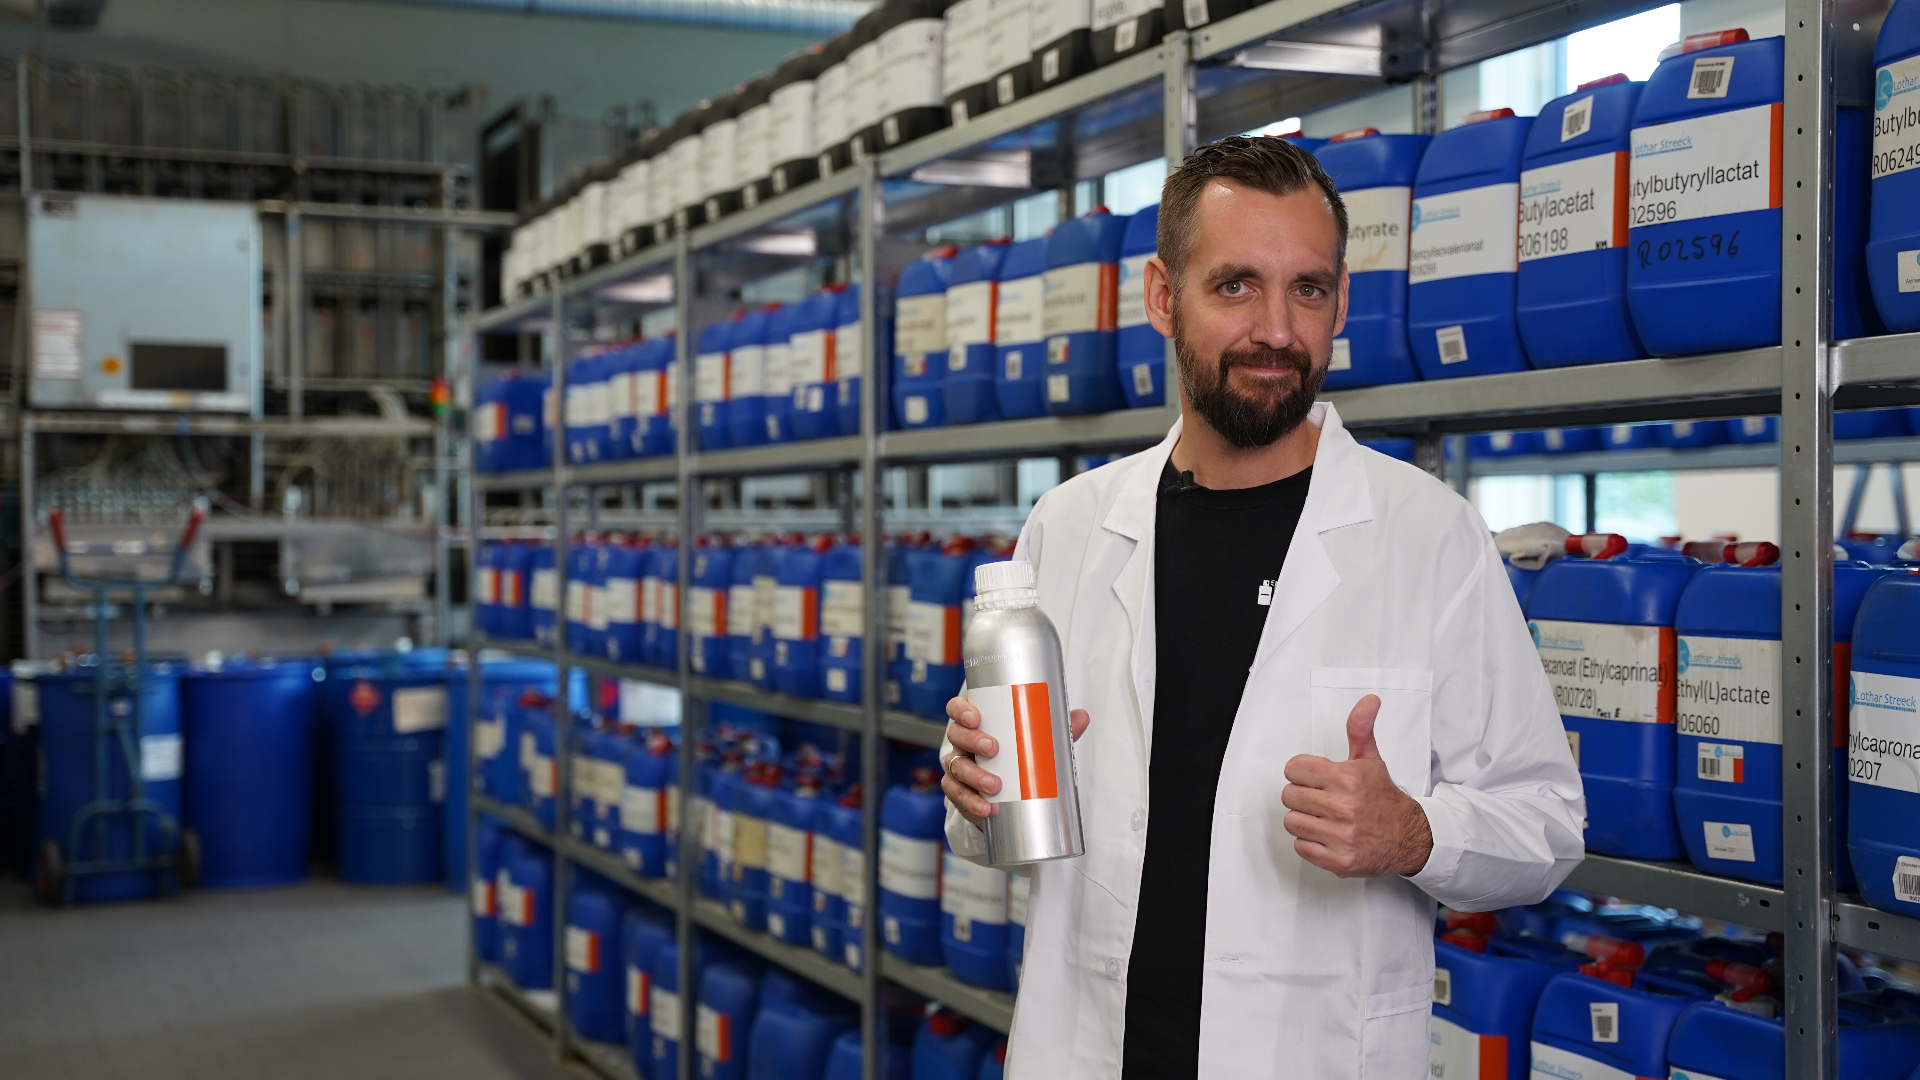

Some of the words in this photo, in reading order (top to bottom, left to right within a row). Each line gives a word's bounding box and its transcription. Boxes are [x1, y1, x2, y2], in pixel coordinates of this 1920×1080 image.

[1893, 76, 1918, 92] Lothar
[1635, 142, 1658, 155] othar
[1660, 135, 1692, 149] Streeck
[1855, 690, 1883, 703] Lothar
[1885, 693, 1917, 708] Streeck
